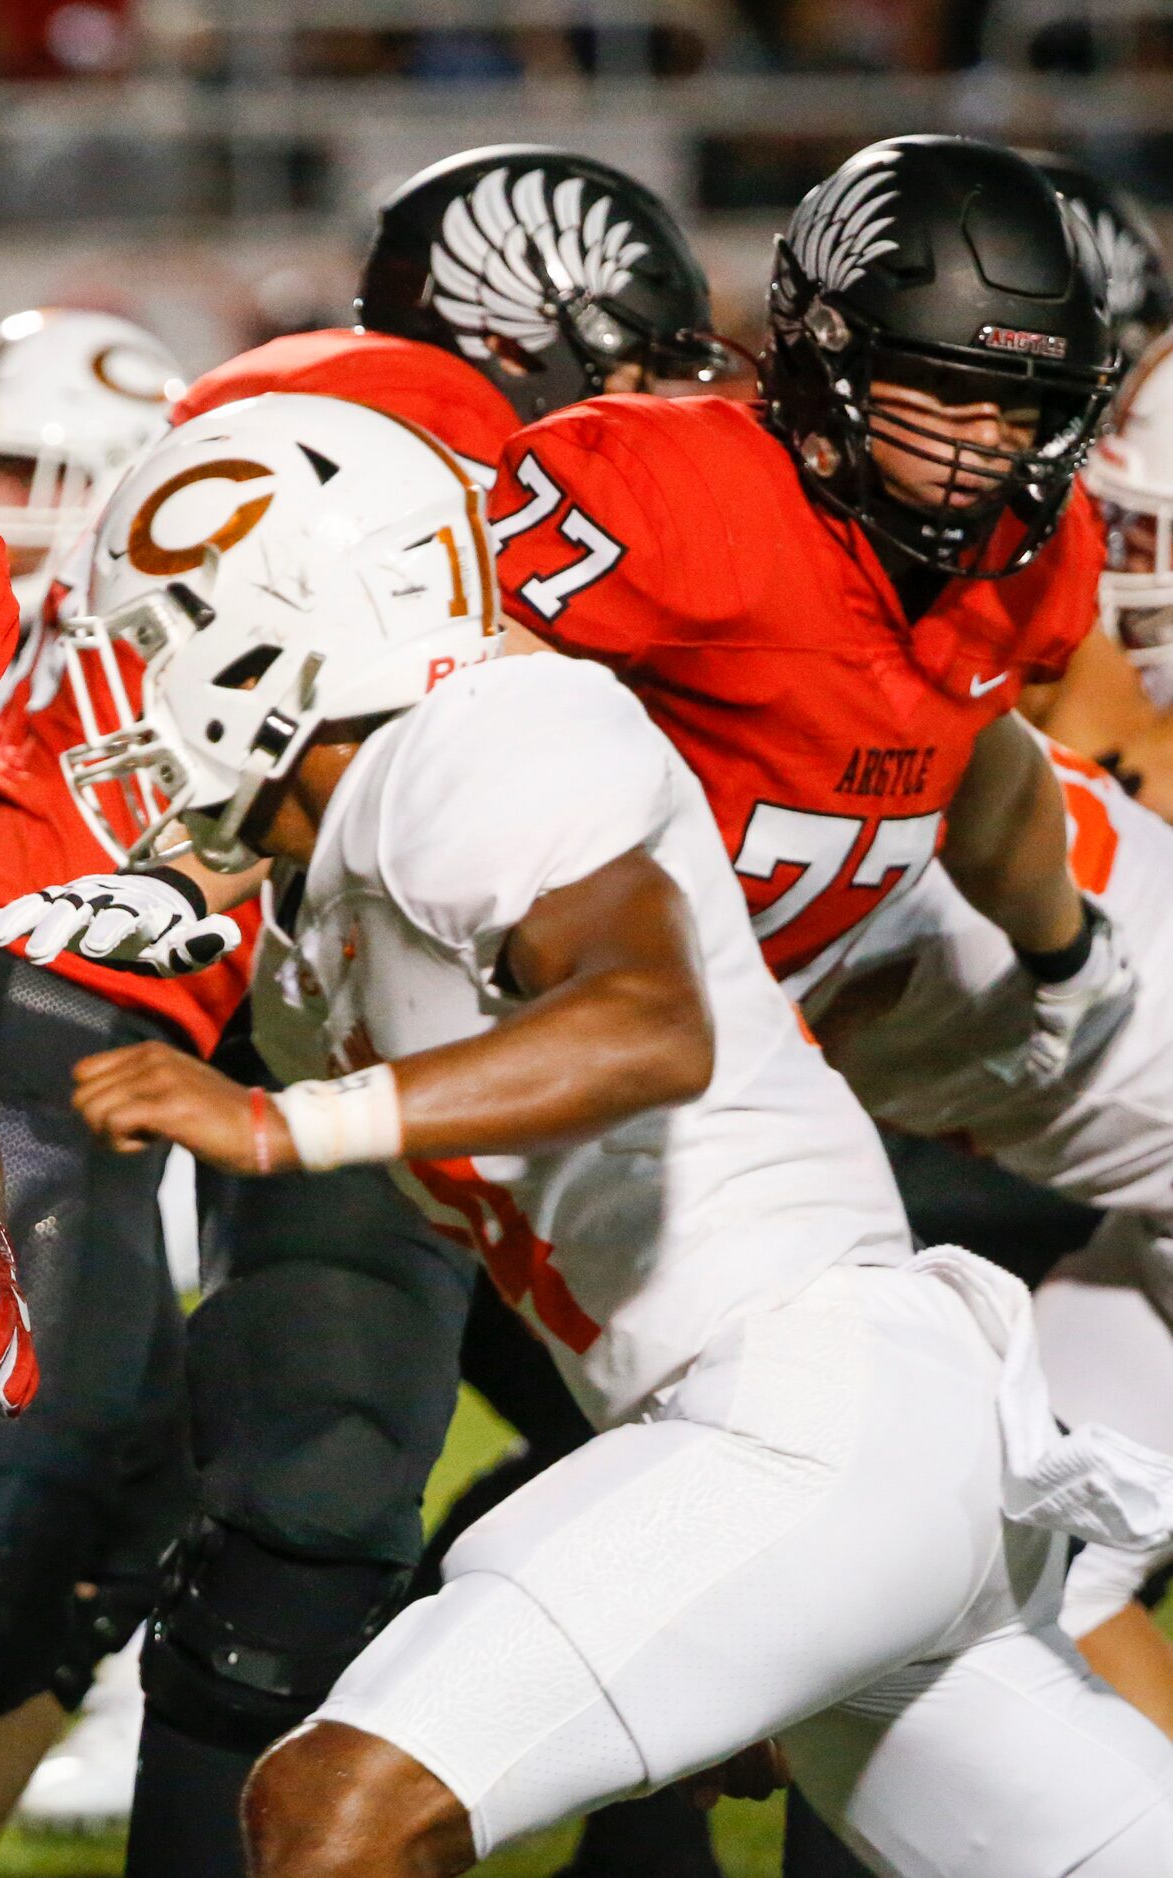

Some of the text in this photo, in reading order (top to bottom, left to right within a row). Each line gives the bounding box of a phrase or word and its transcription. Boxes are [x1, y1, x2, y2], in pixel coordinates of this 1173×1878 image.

[127, 458, 276, 576] C
[834, 746, 936, 796] ARGYLE
[732, 802, 942, 1001] 77
